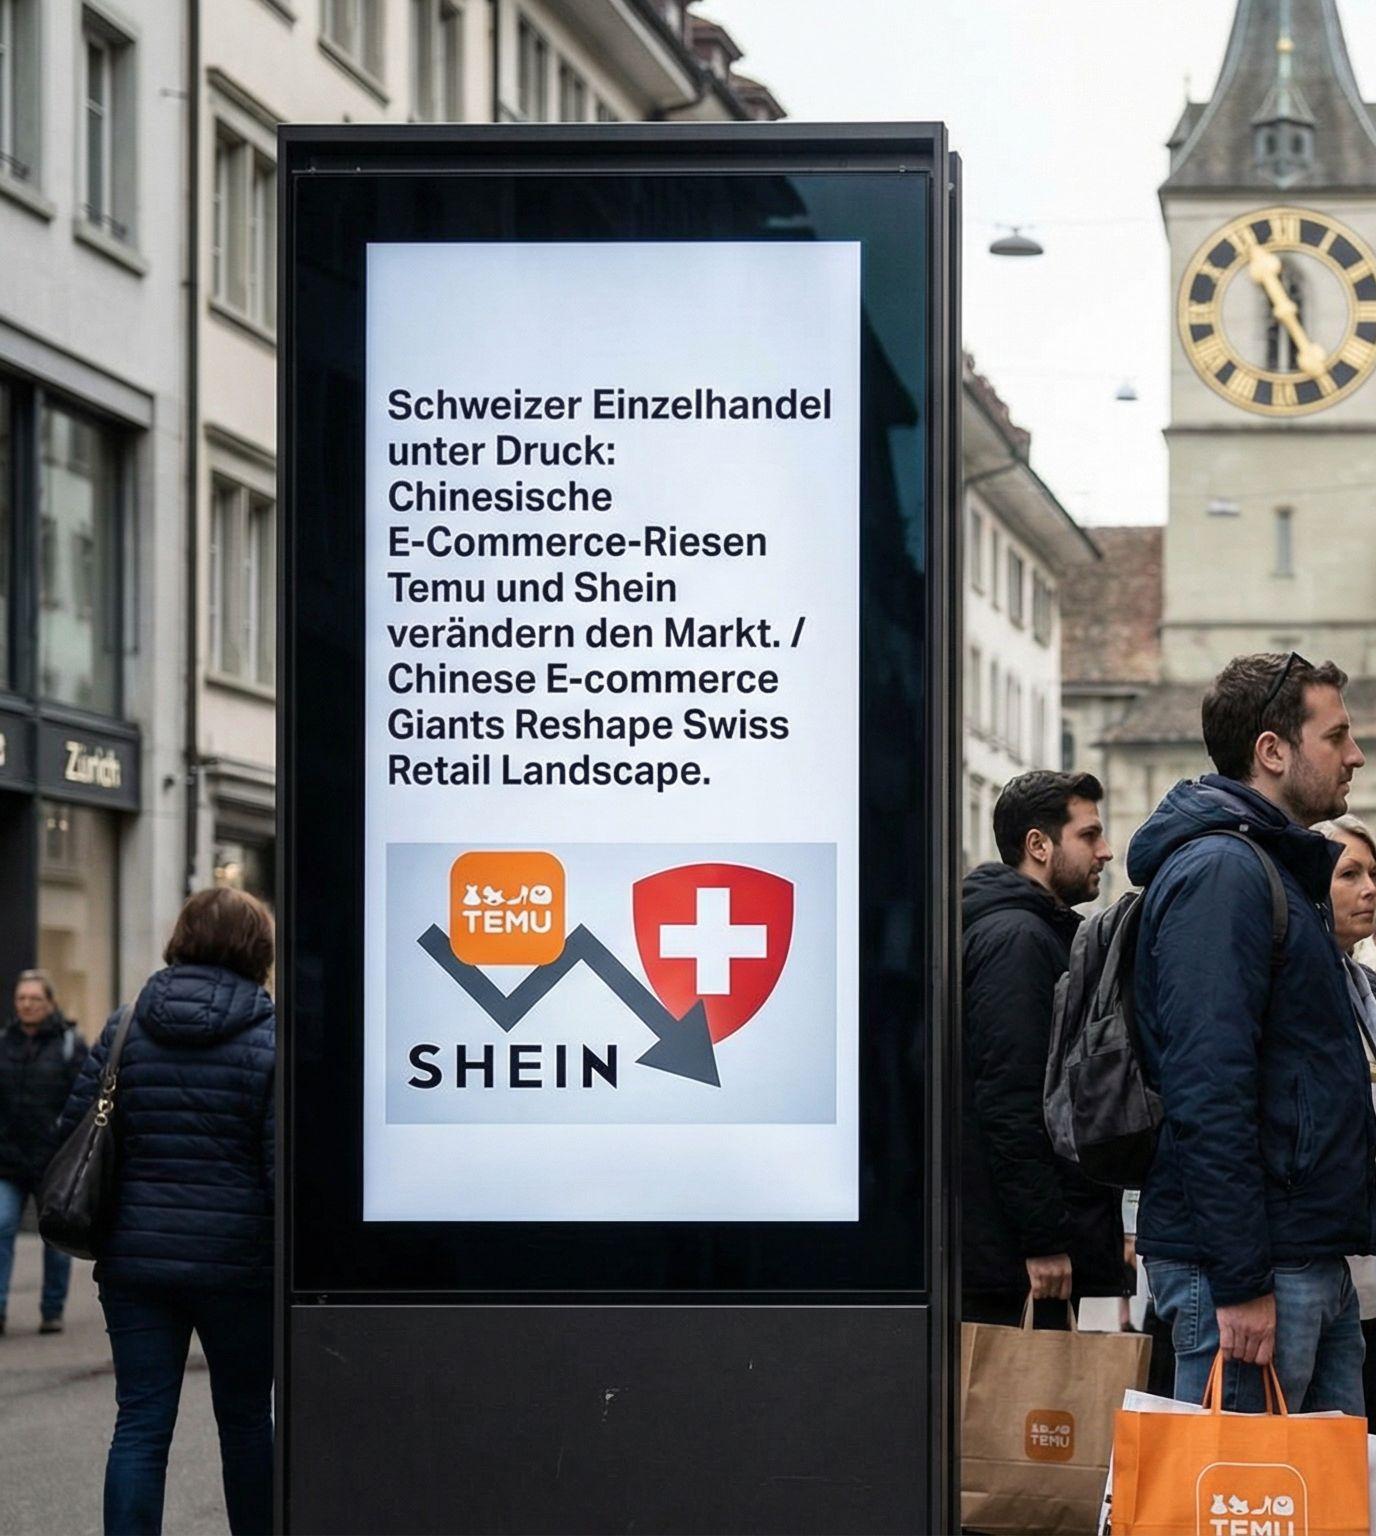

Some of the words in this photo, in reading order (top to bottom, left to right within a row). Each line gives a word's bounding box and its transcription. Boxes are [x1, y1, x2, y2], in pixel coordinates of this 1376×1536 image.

[387, 388, 583, 421] Schweizer
[593, 388, 831, 420] Einzelhandel
[388, 436, 486, 467] unter
[496, 434, 615, 466] Druck:
[388, 480, 613, 512] Chinesische
[389, 525, 767, 558] E-Commerce-Riesen
[387, 571, 485, 603] Temu
[497, 571, 564, 603] und
[574, 571, 676, 603] Shein
[386, 616, 574, 649] verändern
[585, 617, 653, 649] den
[665, 616, 780, 649] Markt.
[790, 616, 806, 648] /
[388, 662, 536, 694] Chinese
[547, 662, 779, 694] E-commerce
[387, 708, 505, 740] Giants
[515, 708, 673, 747] Reshape
[683, 708, 789, 740] Swiss
[388, 753, 490, 786] Retail
[502, 754, 710, 793] Landscape.
[462, 909, 553, 935] TEMU
[407, 1043, 619, 1089] SHEIN
[1030, 1434, 1070, 1448] TEMU
